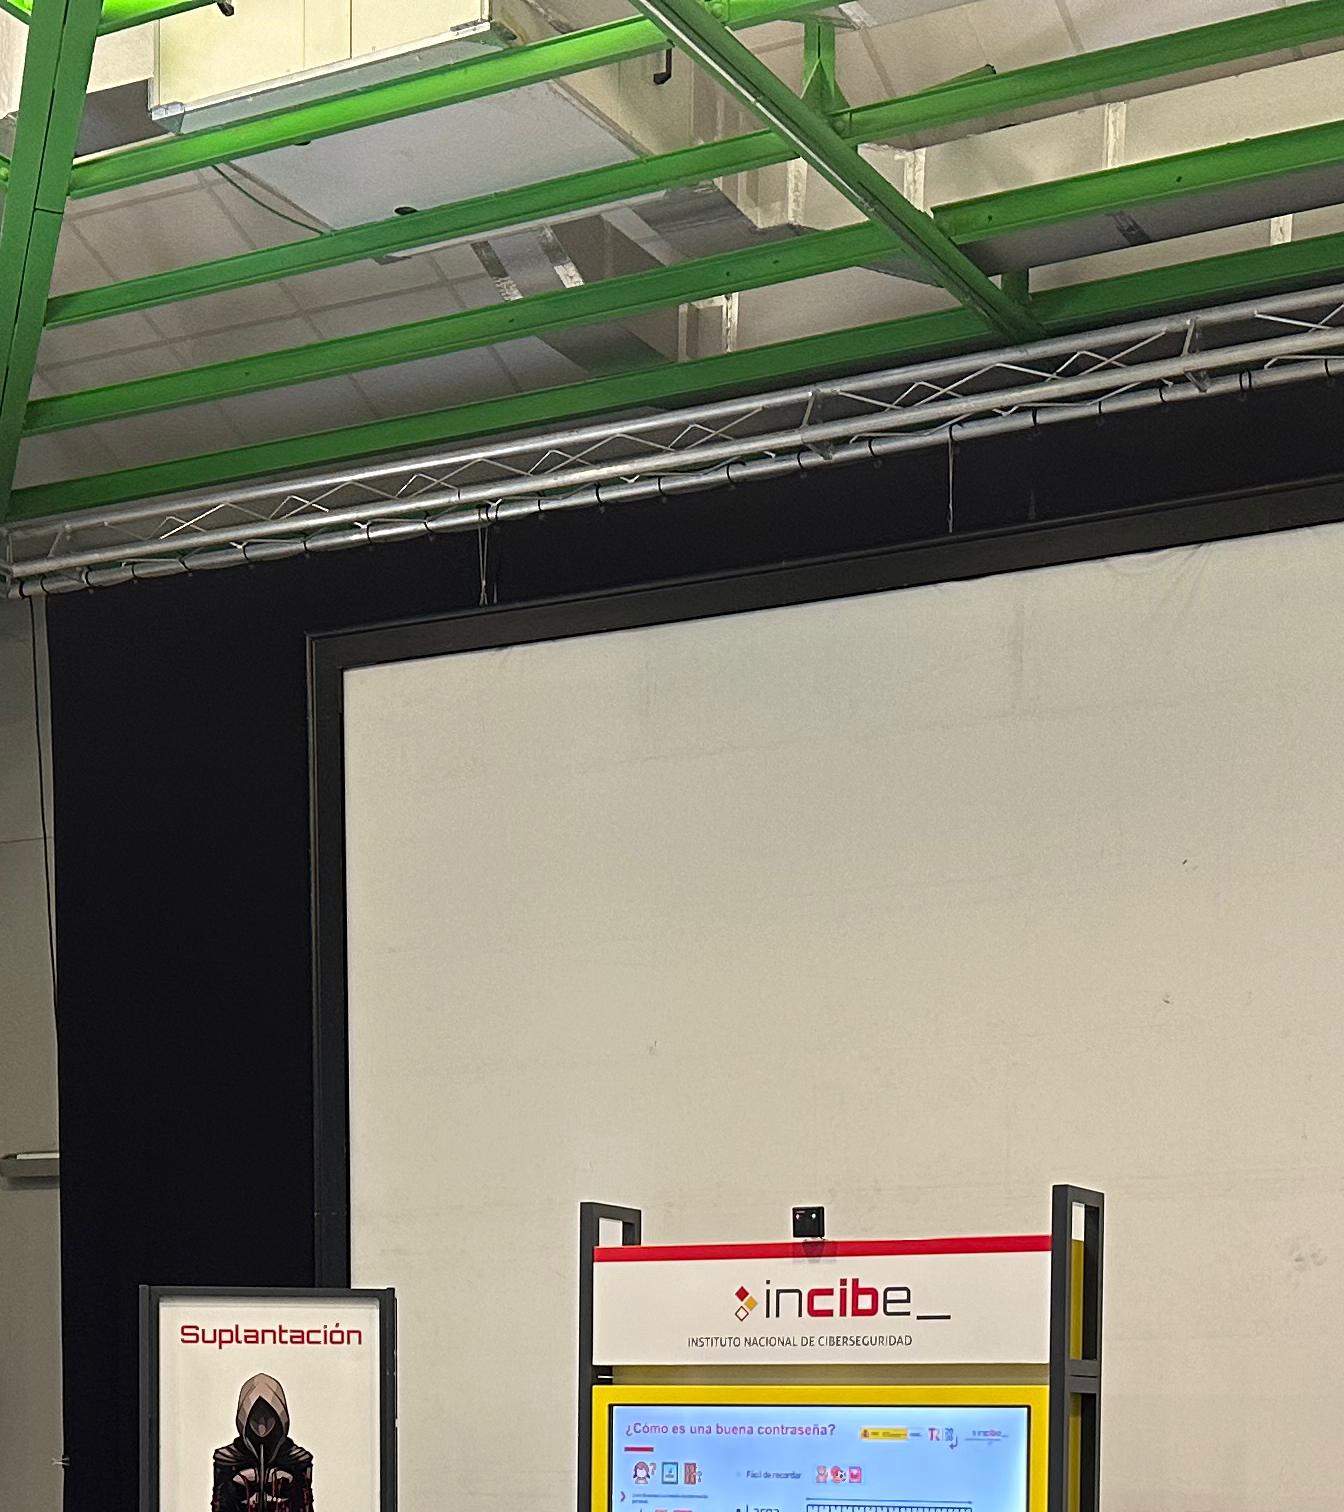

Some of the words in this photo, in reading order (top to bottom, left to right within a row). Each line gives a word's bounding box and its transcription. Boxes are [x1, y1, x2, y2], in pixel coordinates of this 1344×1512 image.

[180, 1322, 363, 1350] Suplantación
[687, 1337, 741, 1348] INSTITUTO
[743, 1336, 798, 1348] NACIONAL
[800, 1336, 816, 1347] DE
[817, 1335, 913, 1347] CIBERSEGURIDAD
[672, 1425, 686, 1434] es
[690, 1425, 712, 1435] una
[716, 1423, 754, 1435] buena
[757, 1423, 836, 1436] contraseña?
